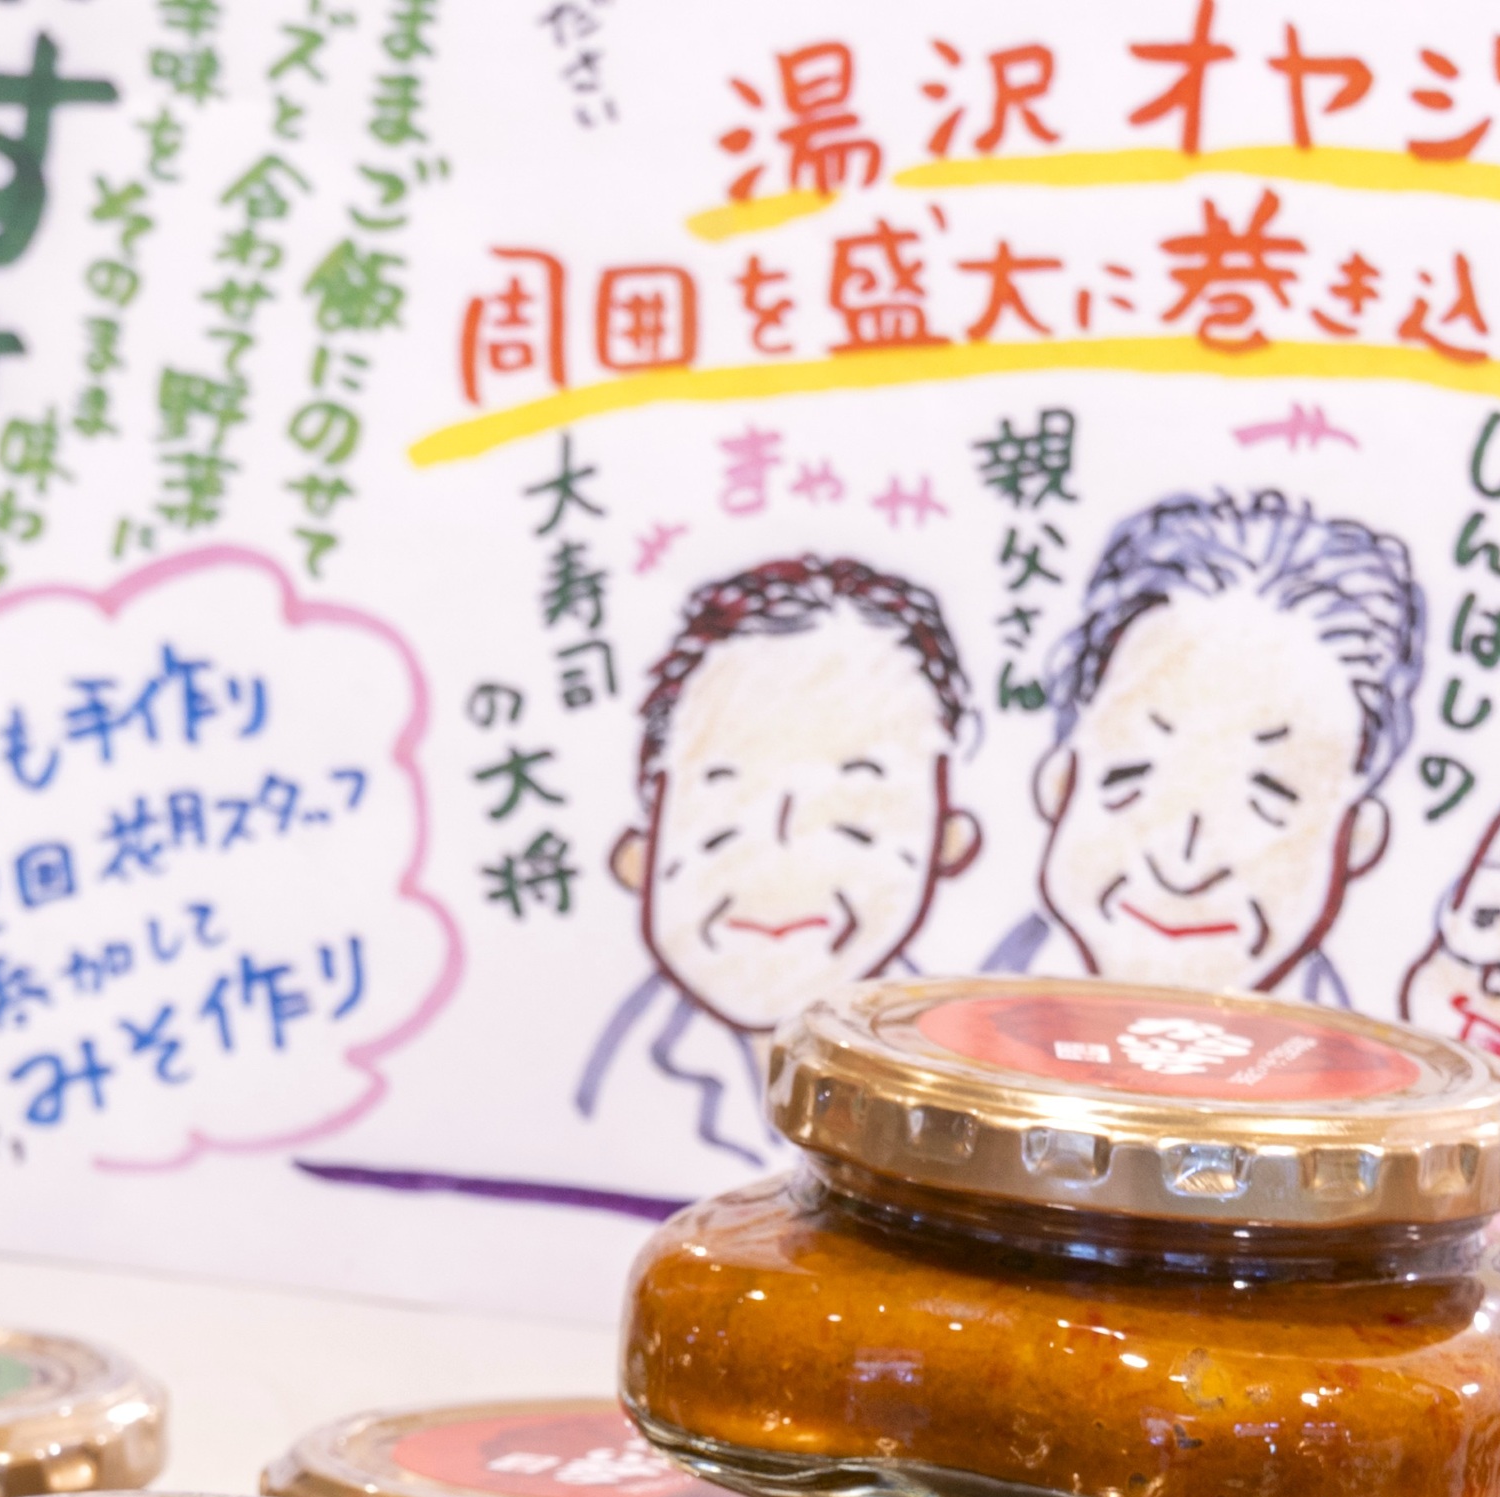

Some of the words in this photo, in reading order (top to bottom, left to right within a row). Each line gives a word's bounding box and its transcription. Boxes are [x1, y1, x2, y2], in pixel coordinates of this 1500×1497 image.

[522, 430, 619, 710] 大寿司
[970, 408, 1079, 713] 親父さん
[466, 680, 581, 922] の大将
